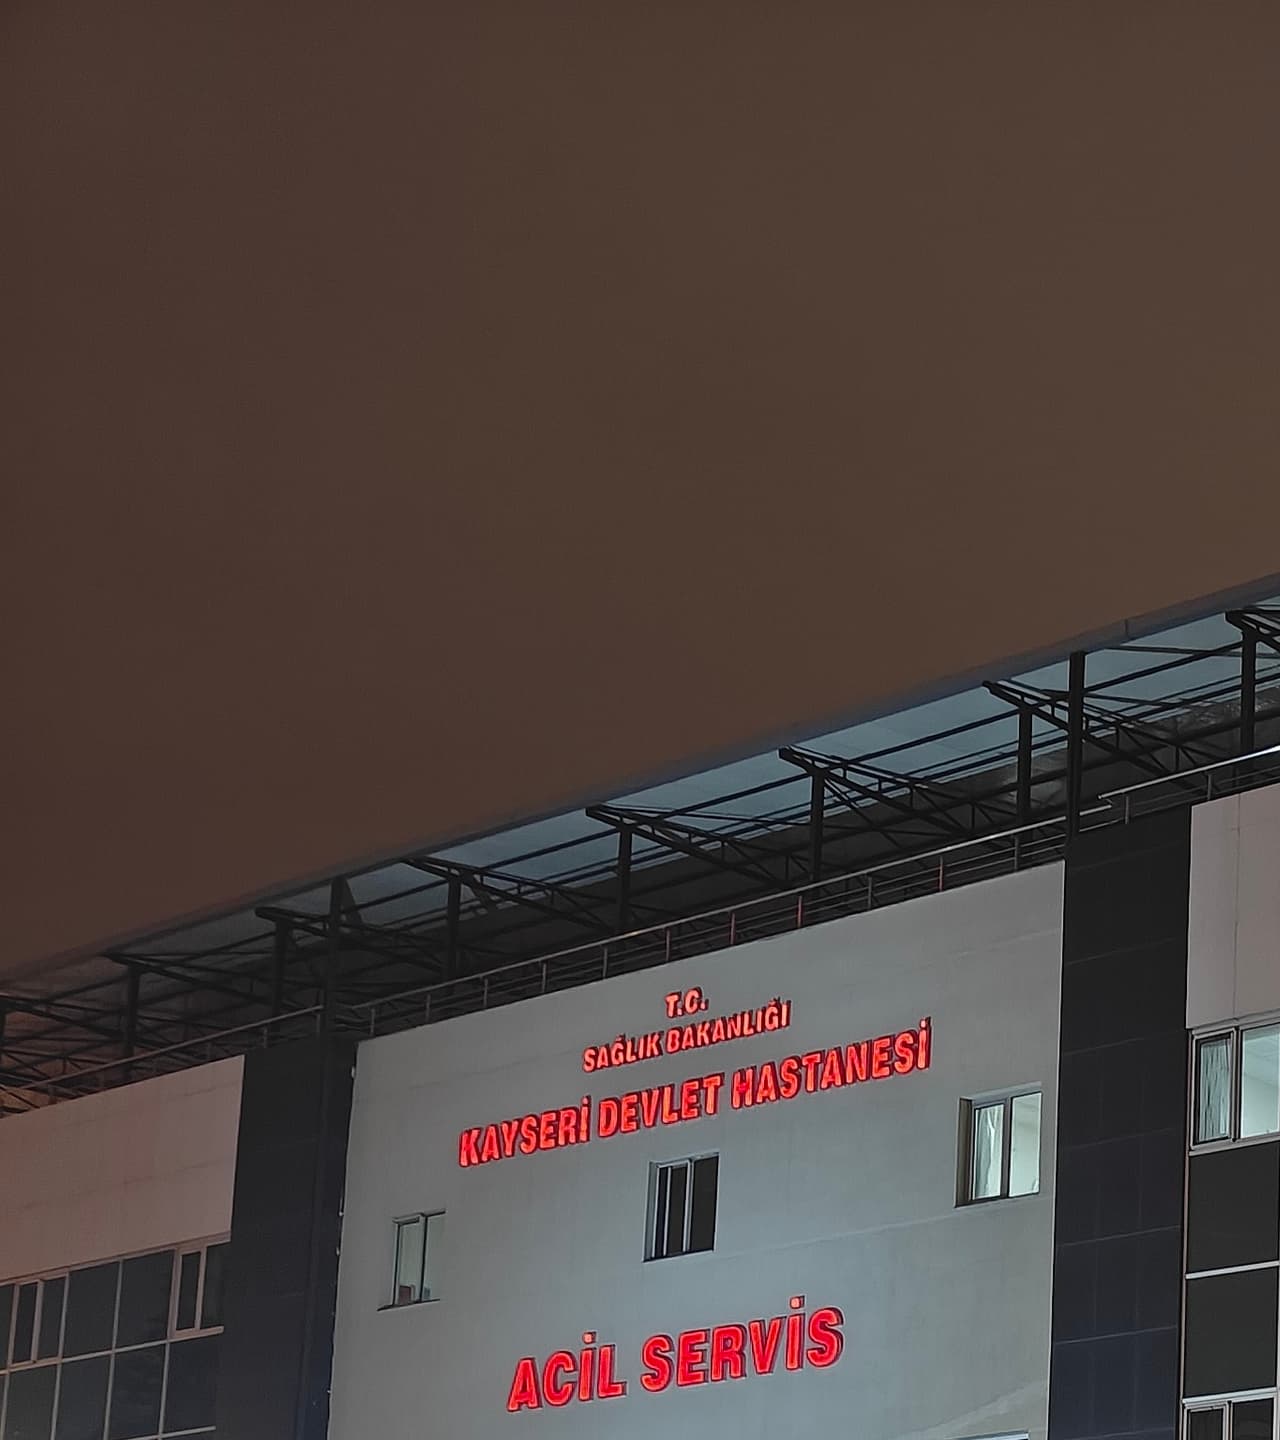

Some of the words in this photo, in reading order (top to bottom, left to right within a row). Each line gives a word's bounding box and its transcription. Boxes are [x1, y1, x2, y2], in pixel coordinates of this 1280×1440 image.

[582, 1033, 662, 1073] SAĞLIK
[665, 999, 790, 1054] BAKANLIĞI
[665, 987, 708, 1018] T.C.
[459, 1097, 590, 1167] KAYSERİ
[597, 1075, 724, 1137] DEVLET
[731, 1019, 932, 1109] HASTANESİ
[507, 1333, 626, 1412] ACİL
[640, 1296, 844, 1393] SERVİS
